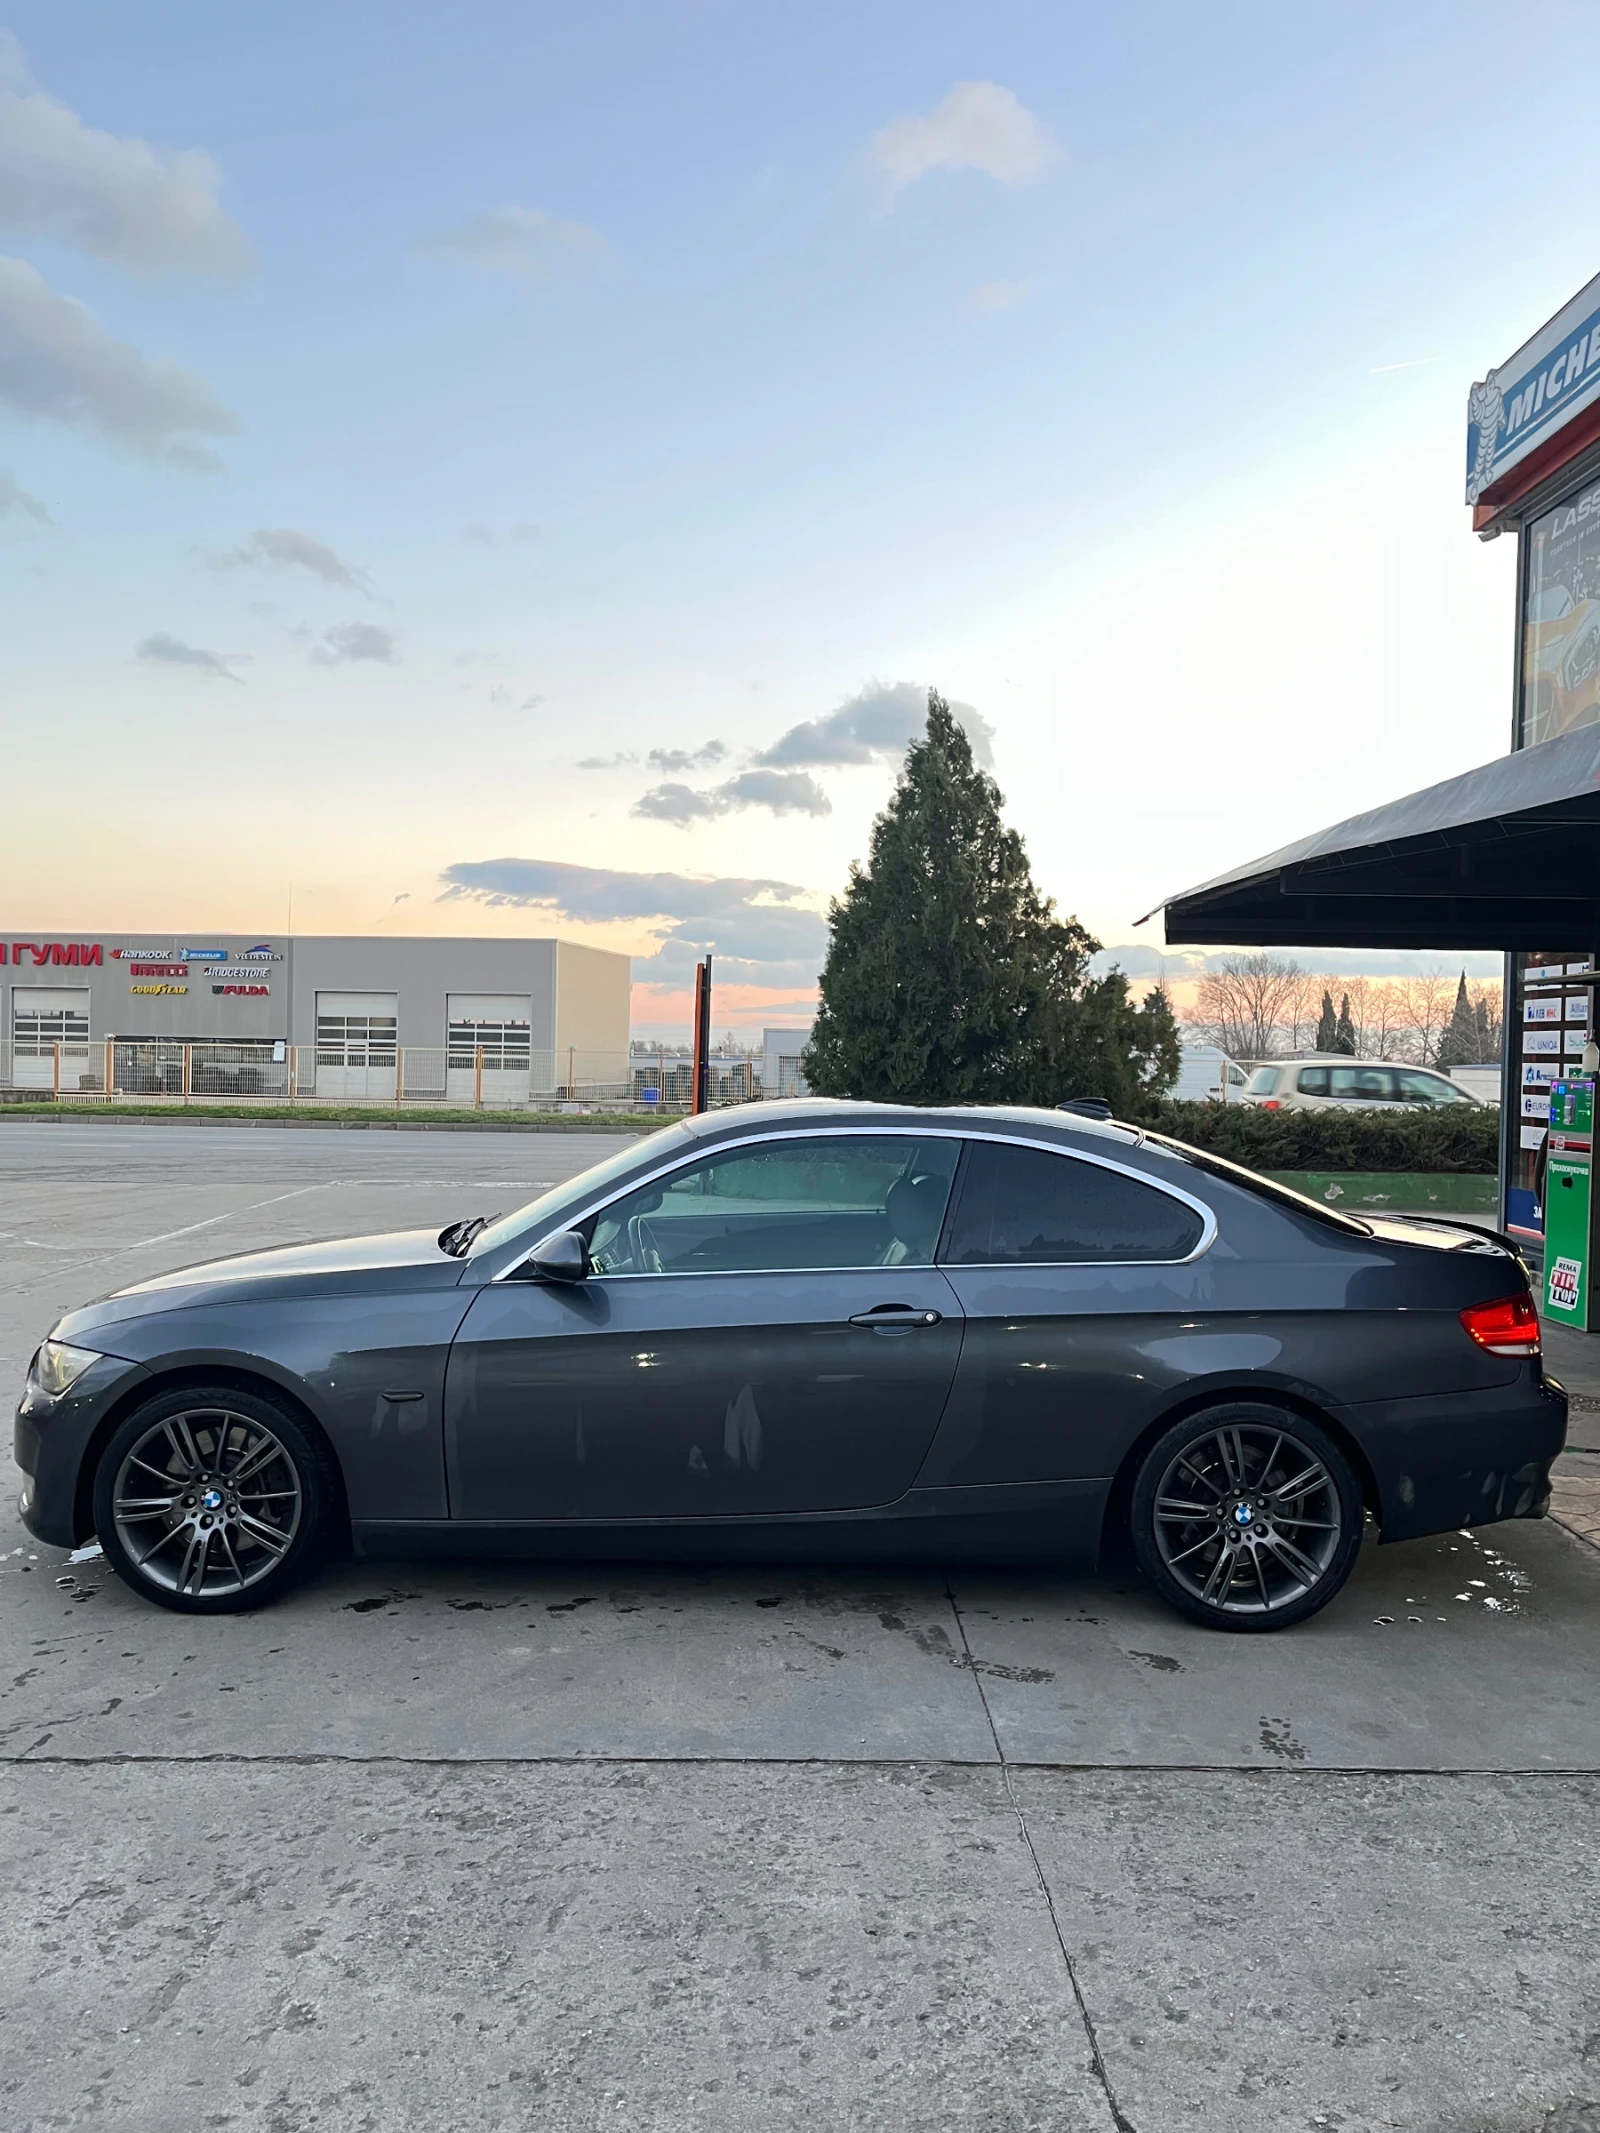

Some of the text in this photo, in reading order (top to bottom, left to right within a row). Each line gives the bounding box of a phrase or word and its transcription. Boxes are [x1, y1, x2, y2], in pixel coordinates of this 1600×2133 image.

[12, 943, 103, 966] ГУМИ
[130, 963, 188, 976] PIRELLI
[204, 966, 270, 978] BRIDGESTONE
[222, 985, 269, 996] FULDA
[1558, 1262, 1577, 1273] REMA
[1553, 1270, 1575, 1289] TIP
[1554, 1286, 1576, 1303] TOP
